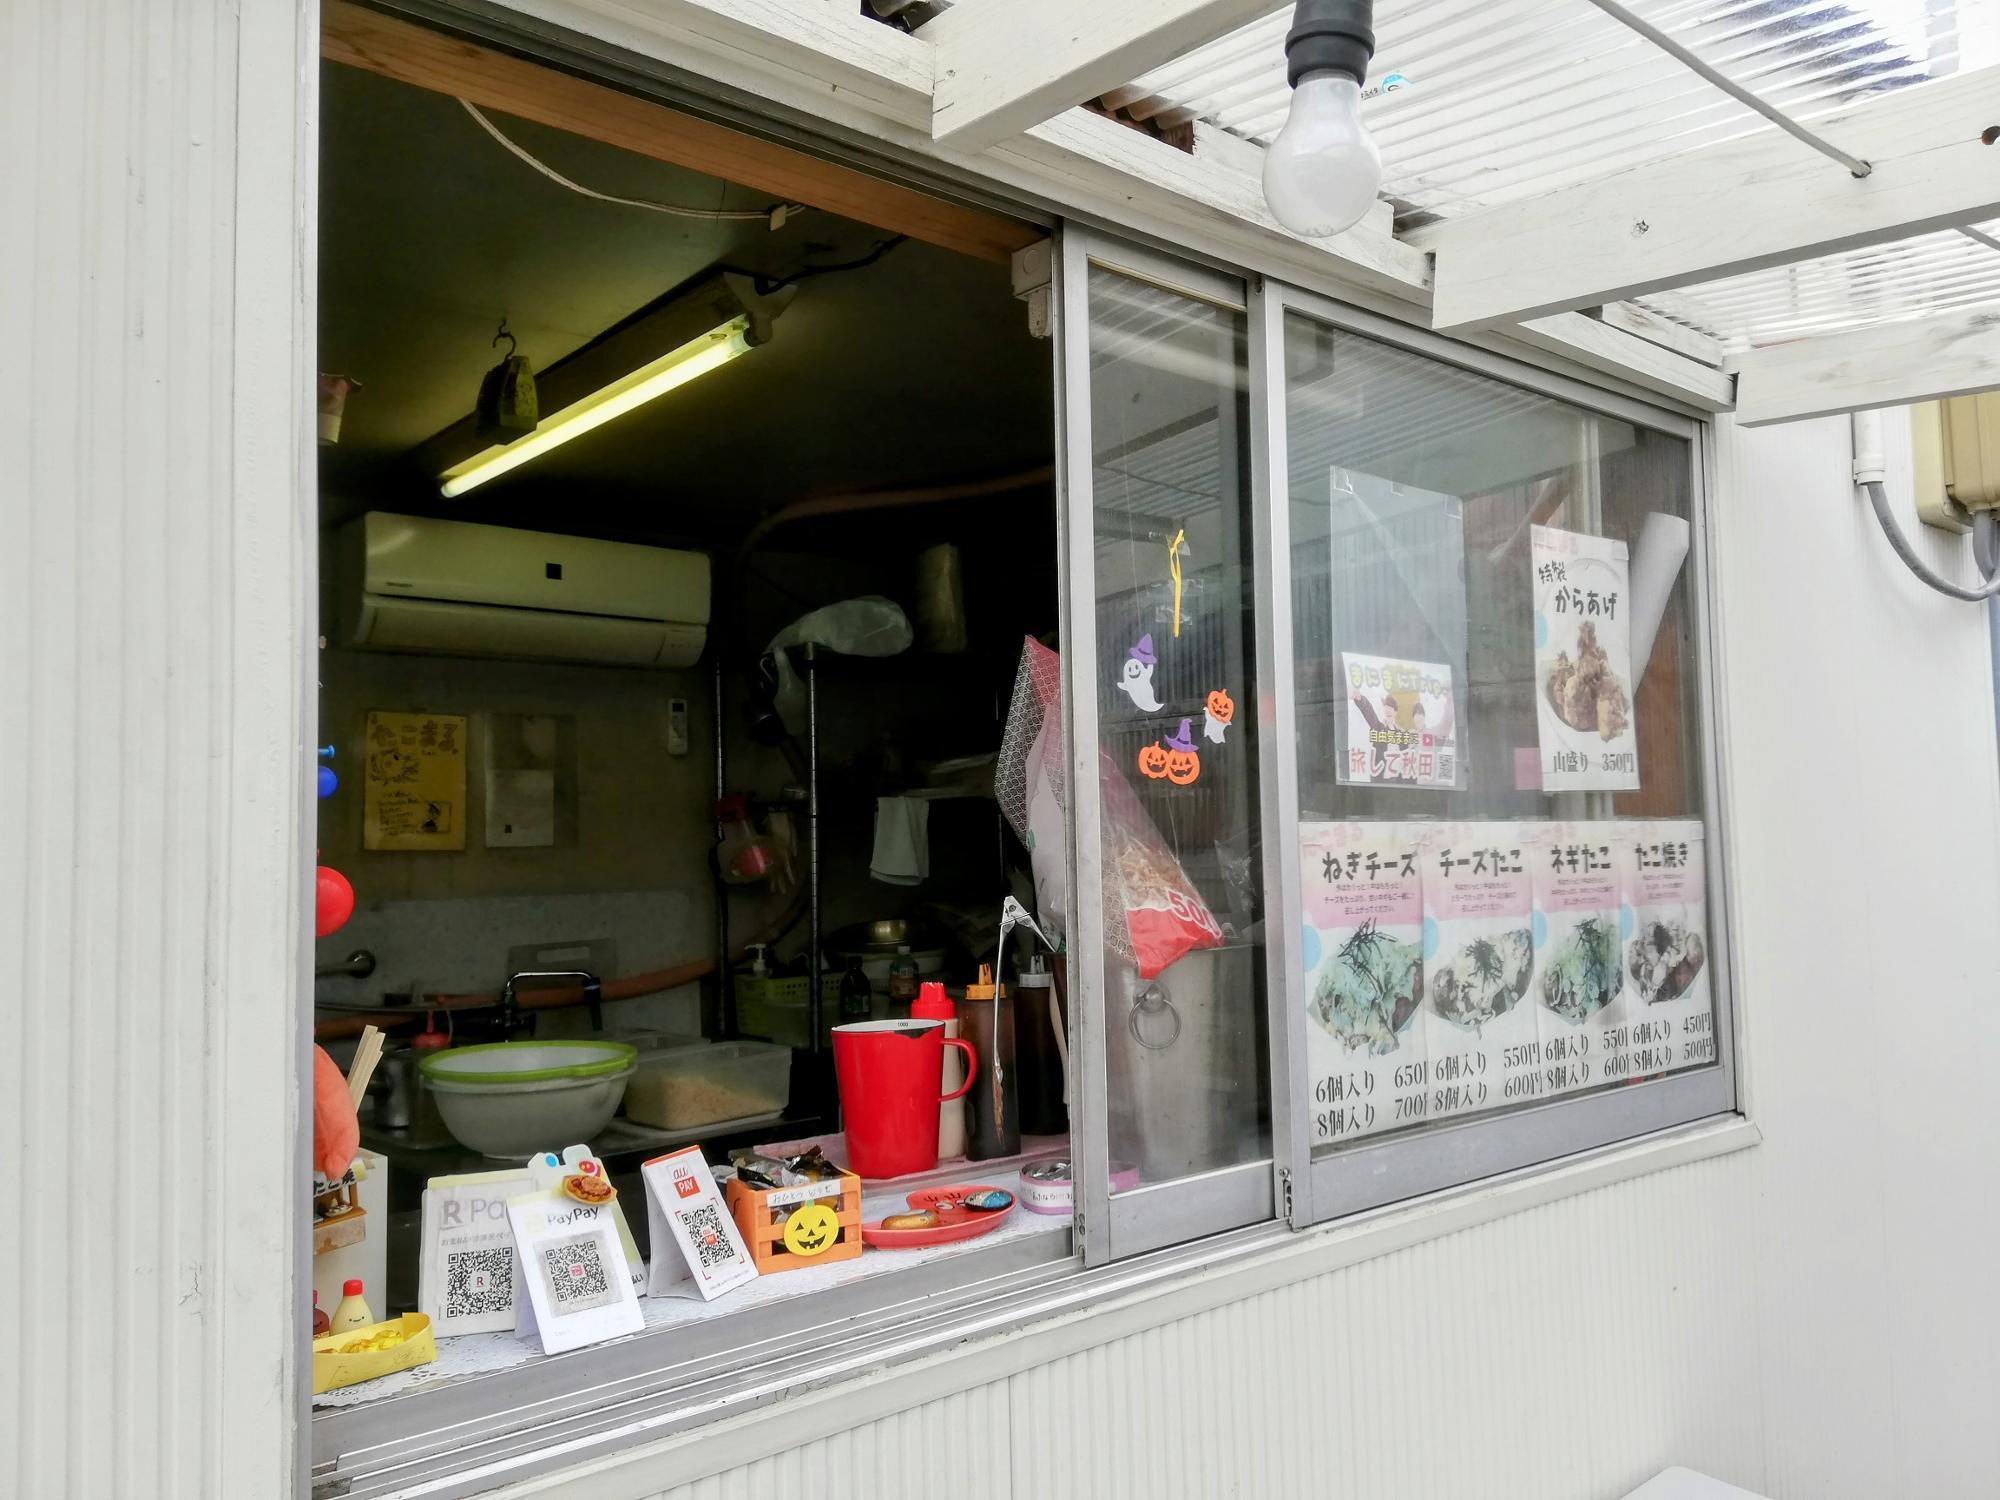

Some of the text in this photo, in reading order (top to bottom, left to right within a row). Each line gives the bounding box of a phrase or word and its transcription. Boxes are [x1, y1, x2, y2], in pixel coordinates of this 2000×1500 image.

[1538, 560, 1567, 584] 特製
[1555, 586, 1617, 620] からあげ
[1370, 730, 1419, 744] 自由気ままに
[1350, 747, 1433, 777] 旅して秋田
[1553, 751, 1634, 773] 山盛り 350円
[1322, 851, 1418, 883] ねぎチーズ
[1439, 847, 1523, 877] チーズたこ
[1551, 843, 1612, 873] ネギたこ
[1635, 841, 1689, 871] たこ焼き
[1546, 1026, 1628, 1061] 6個入り 550
[1633, 1012, 1712, 1044] 6個入り 450円
[1436, 1042, 1541, 1080] 6個入り 550円
[1634, 1037, 1713, 1071] 8個入り 500円
[1316, 1061, 1427, 1103] 6個入り 650
[1547, 1053, 1629, 1089] 8個入り 600
[1435, 1070, 1543, 1111] 8個入り 600円
[1318, 1092, 1427, 1137] 8個入り 700
[678, 1178, 696, 1194] PAY
[443, 1197, 506, 1226] R Pa
[547, 1206, 599, 1226] PayPay
